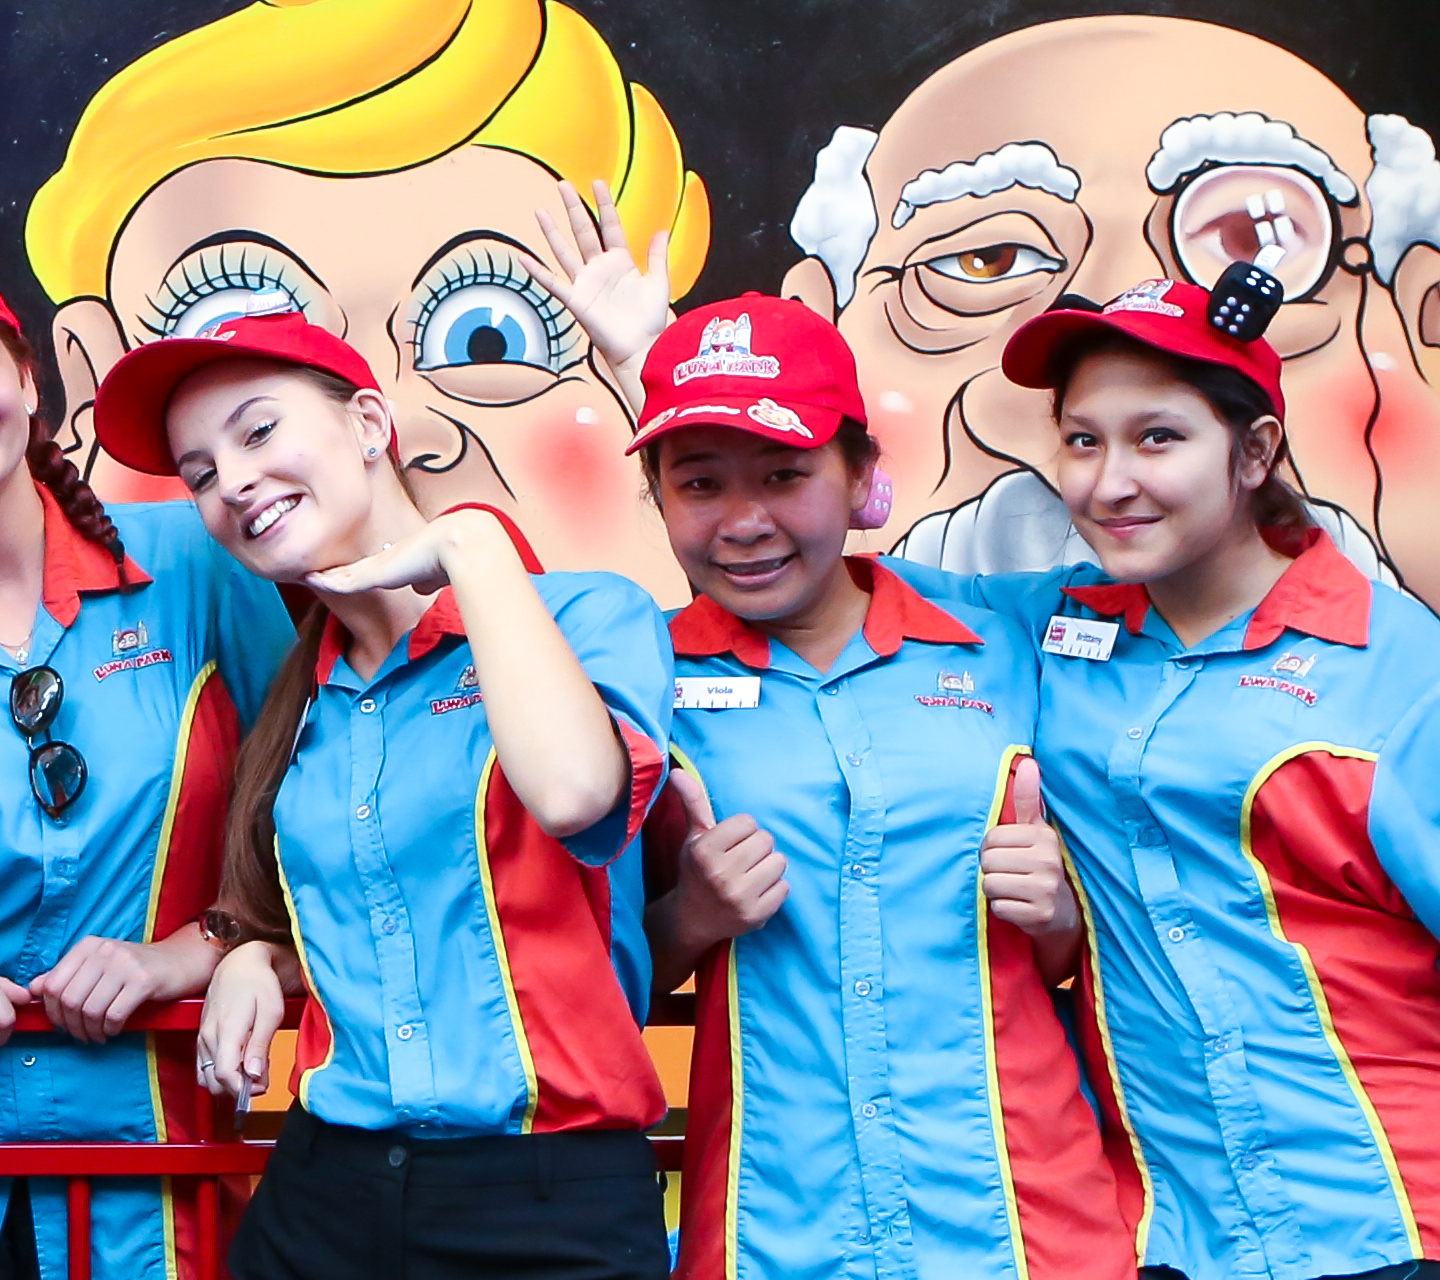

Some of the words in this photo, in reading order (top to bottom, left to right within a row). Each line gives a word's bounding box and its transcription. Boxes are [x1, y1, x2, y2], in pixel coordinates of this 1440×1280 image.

[676, 360, 724, 380] LUNA
[726, 360, 777, 375] PARK
[94, 659, 133, 679] LUNA
[135, 649, 171, 668] PARK
[707, 686, 733, 694] Viola
[1240, 676, 1276, 687] LUNA
[1278, 682, 1316, 705] PARK
[432, 697, 471, 714] LUNA
